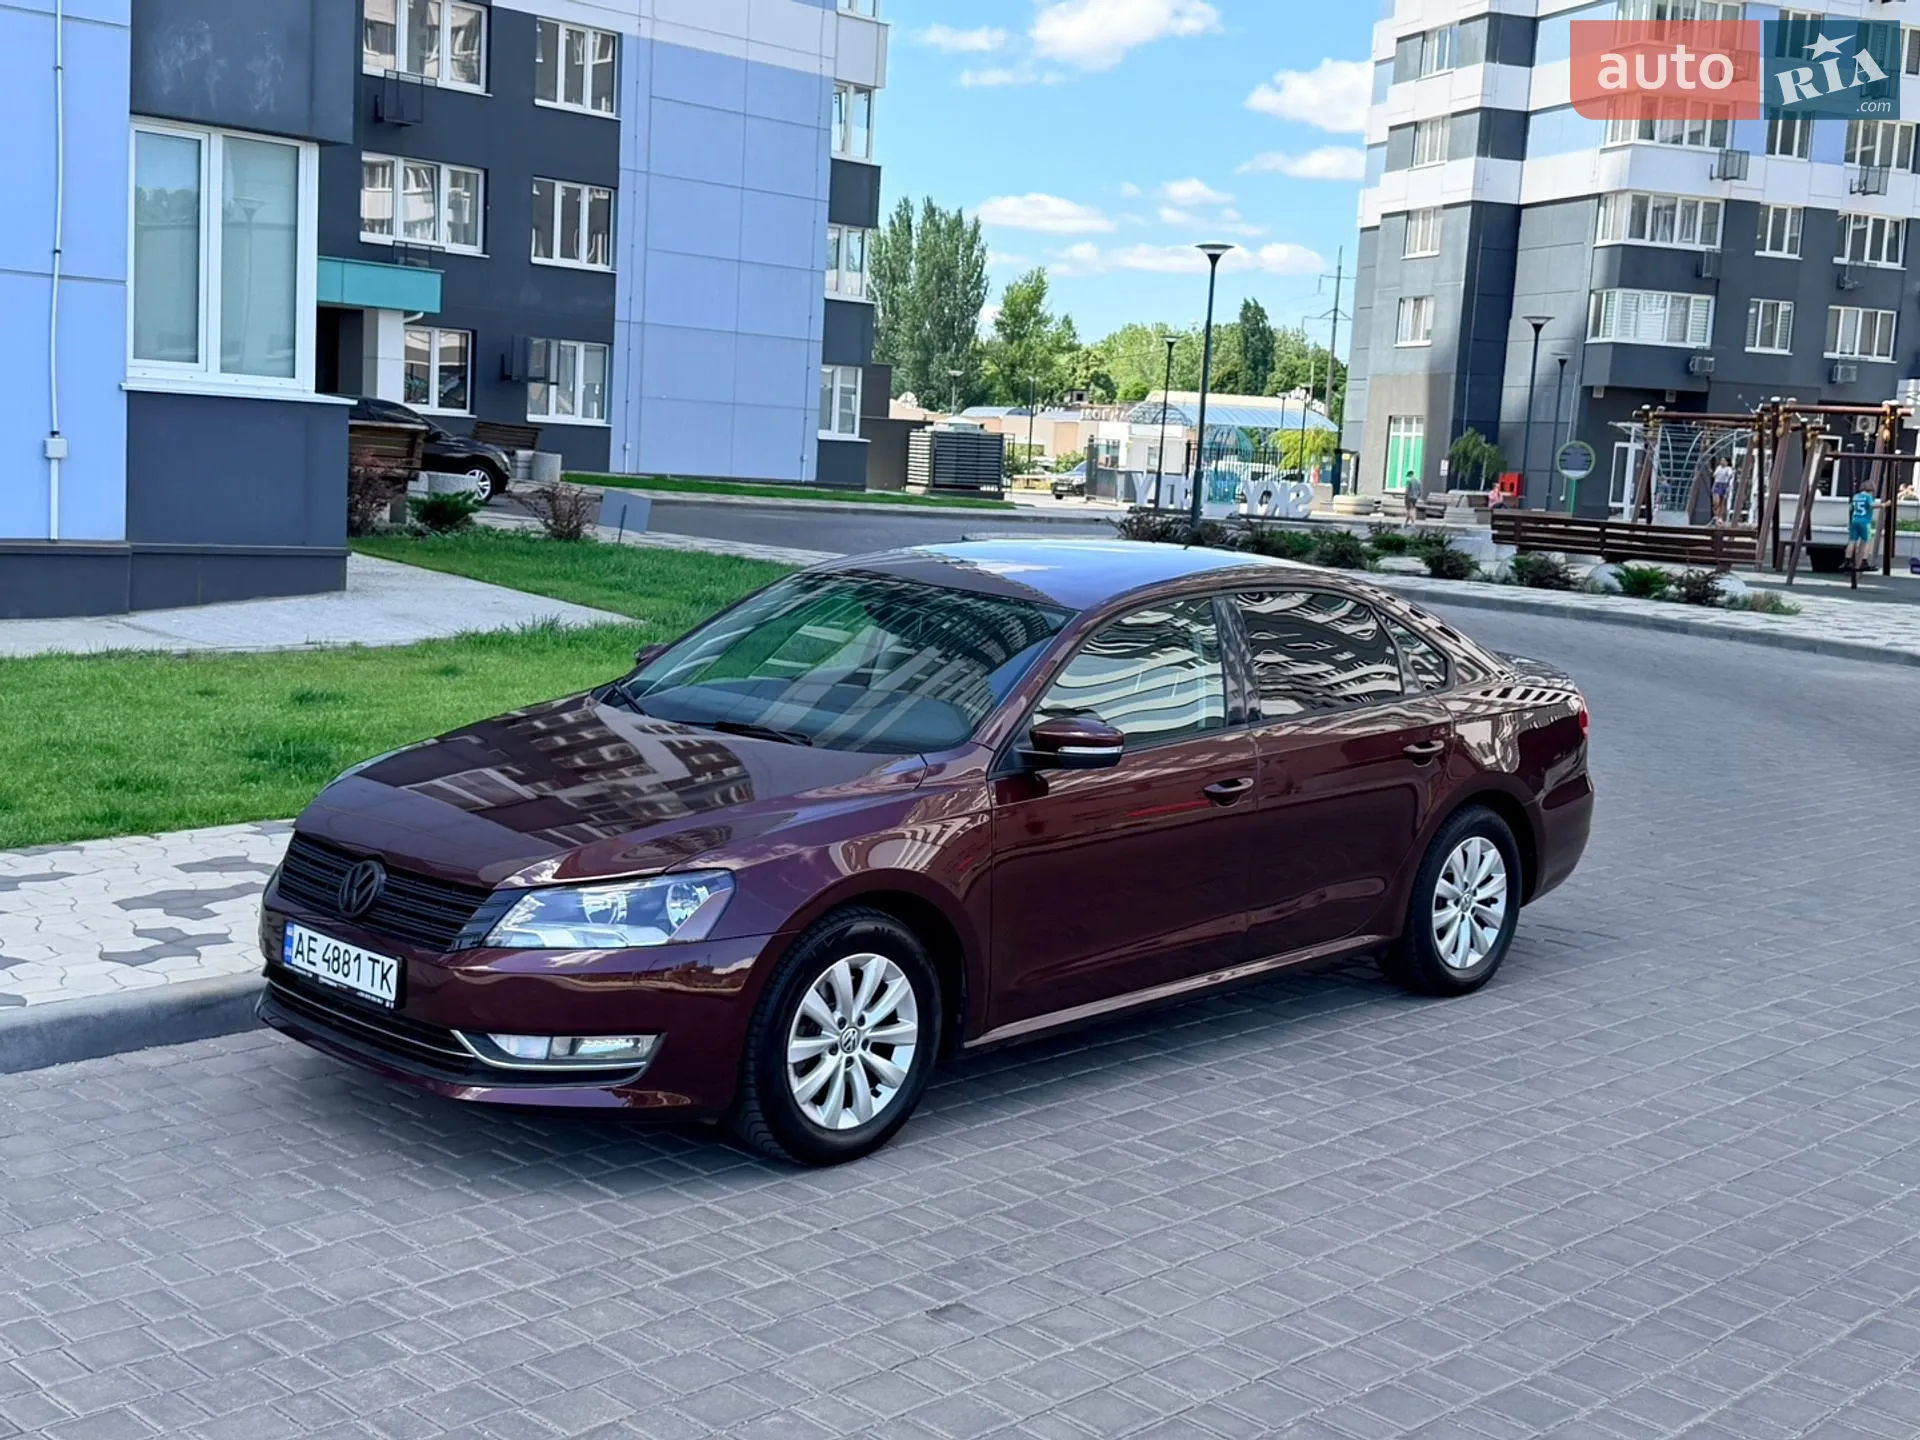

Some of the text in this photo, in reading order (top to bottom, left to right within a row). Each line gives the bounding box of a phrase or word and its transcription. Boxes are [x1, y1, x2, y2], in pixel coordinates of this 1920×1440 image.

[294, 932, 394, 994] AE 4881 TK
